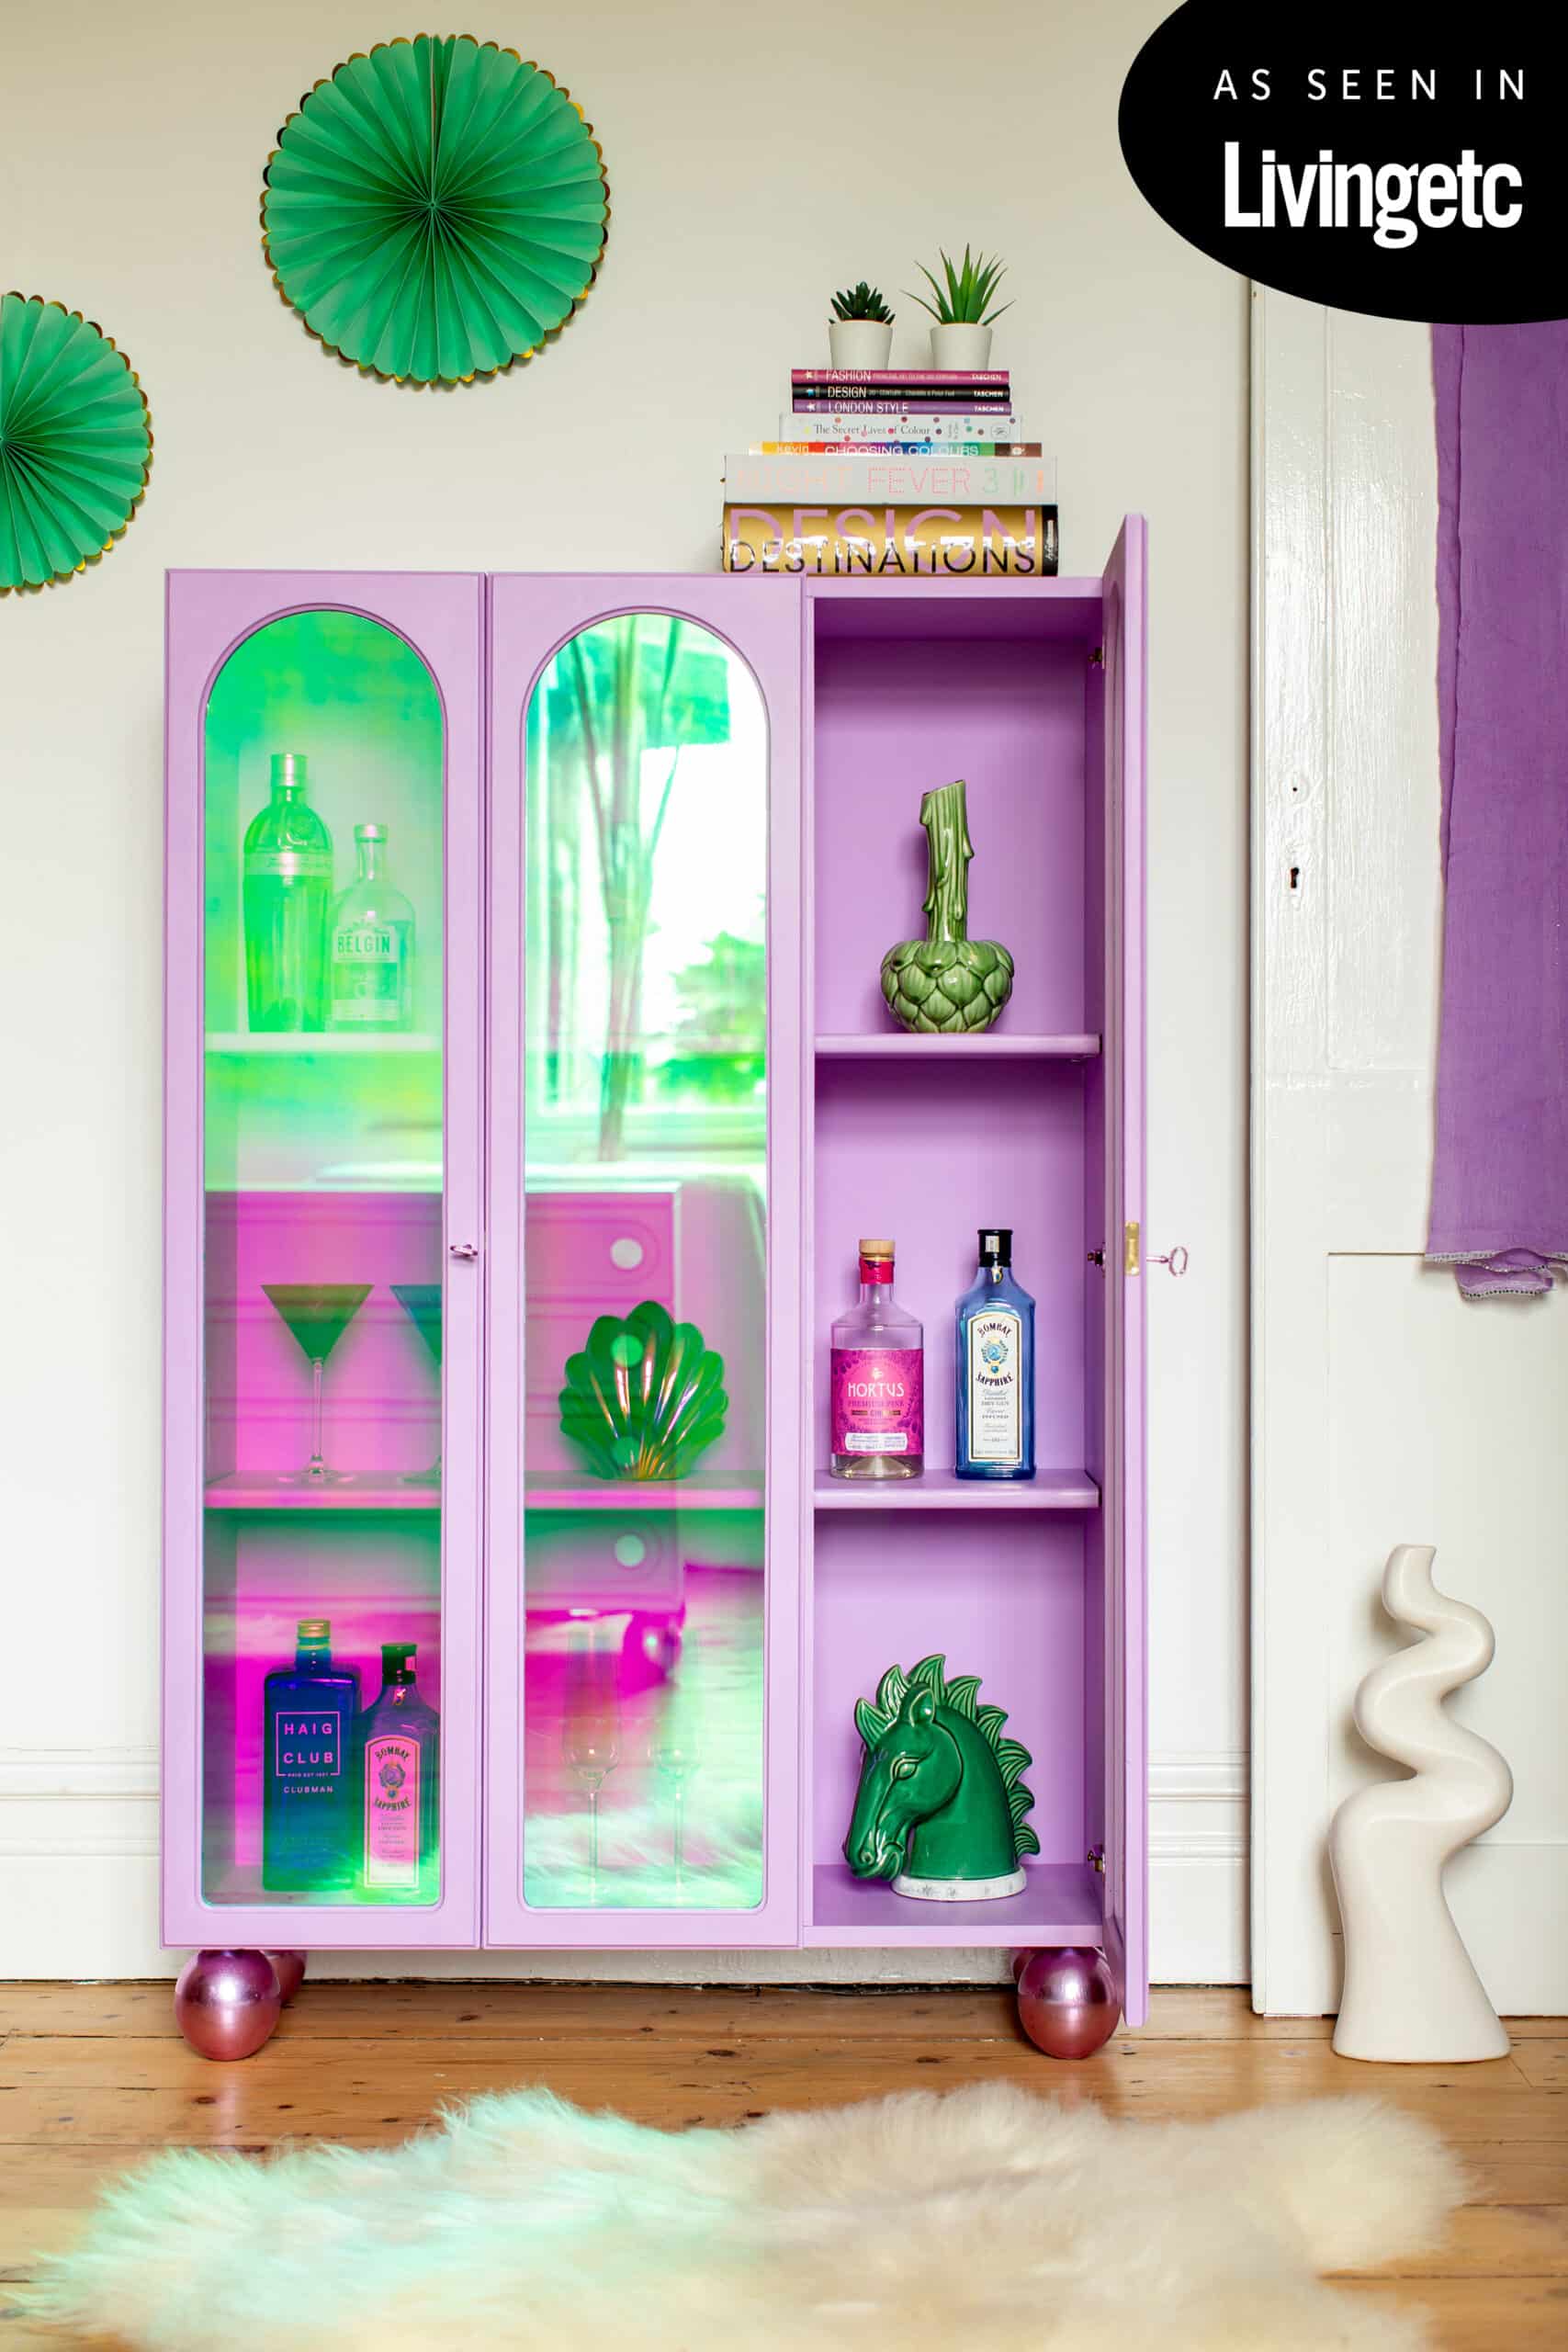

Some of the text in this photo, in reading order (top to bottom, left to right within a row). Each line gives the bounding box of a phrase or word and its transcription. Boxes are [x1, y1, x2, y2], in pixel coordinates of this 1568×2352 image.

[827, 370, 871, 381] FASHION
[828, 387, 866, 398] DESIGN
[829, 402, 908, 413] LONDON STYLE
[814, 424, 829, 435] The
[831, 424, 860, 435] Secret
[863, 424, 886, 435] Lives
[900, 424, 931, 435] Colour
[825, 446, 978, 456] CHOOSING COLOURS
[867, 467, 972, 494] FEVER
[730, 508, 1035, 573] DESIGN
[337, 935, 390, 953] BELGIN
[976, 1323, 1012, 1338] BOMBAY
[975, 1372, 1014, 1386] SAPPHIRE
[848, 1382, 905, 1396] HORTUS
[283, 1723, 333, 1736] HAIG
[283, 1752, 333, 1764] CLUB
[374, 1746, 411, 1761] BOMBAY
[374, 1796, 412, 1812] SAPPHIRE
